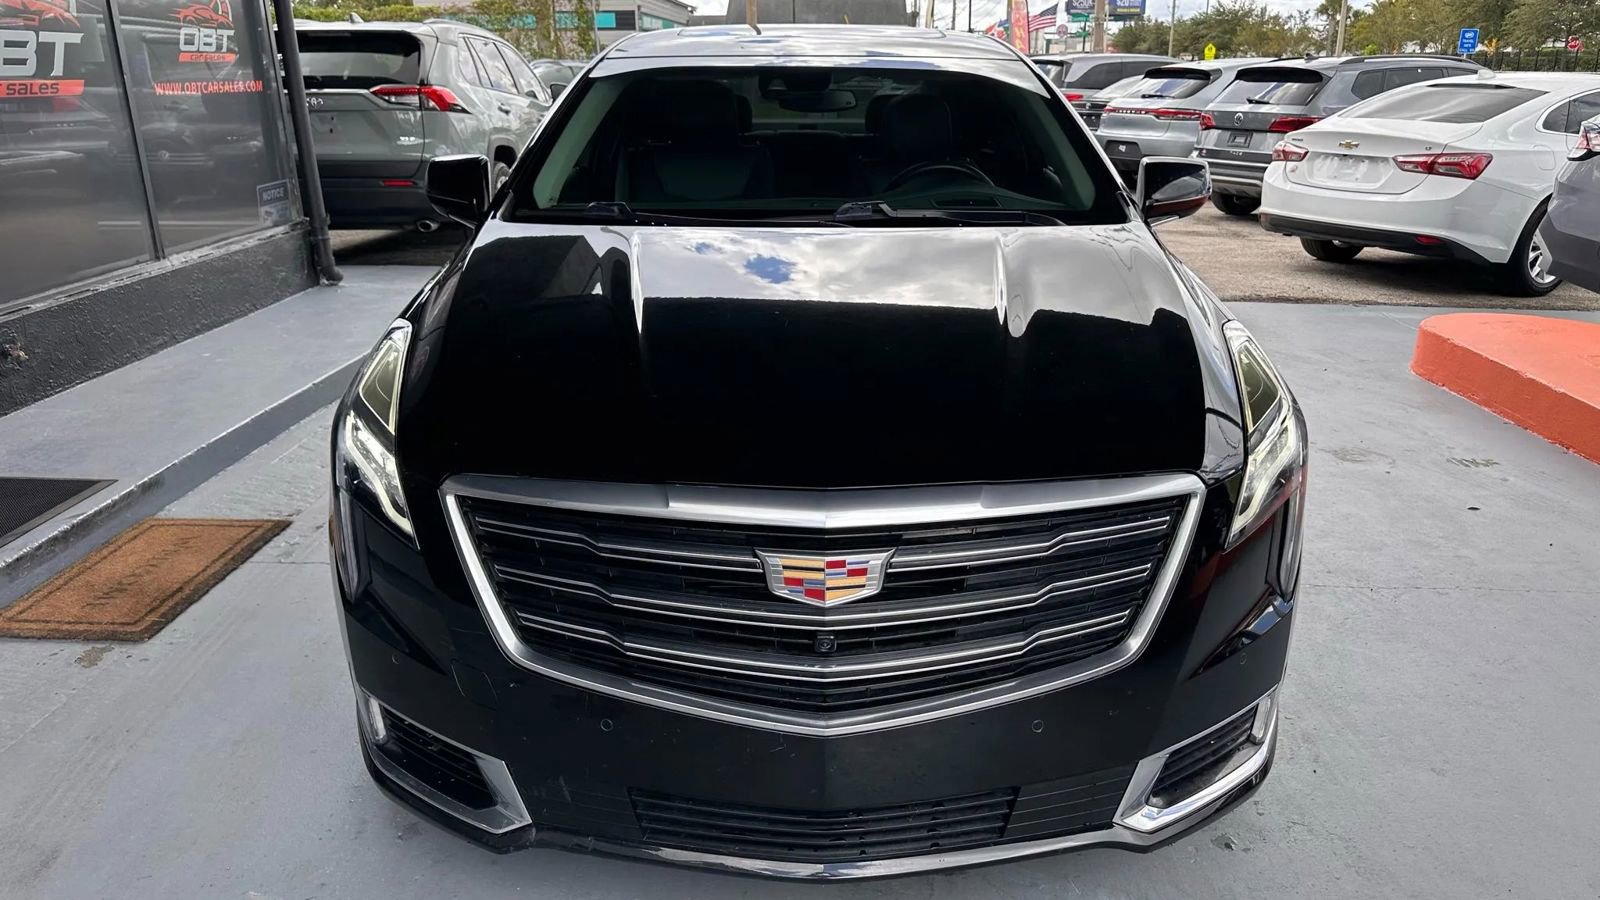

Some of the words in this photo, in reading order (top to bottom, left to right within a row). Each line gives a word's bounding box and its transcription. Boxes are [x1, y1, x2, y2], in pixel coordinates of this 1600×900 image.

[180, 27, 235, 52] OBT
[154, 80, 263, 96] WWW.OBTCARSALES.COM
[263, 187, 284, 201] NOTICE
